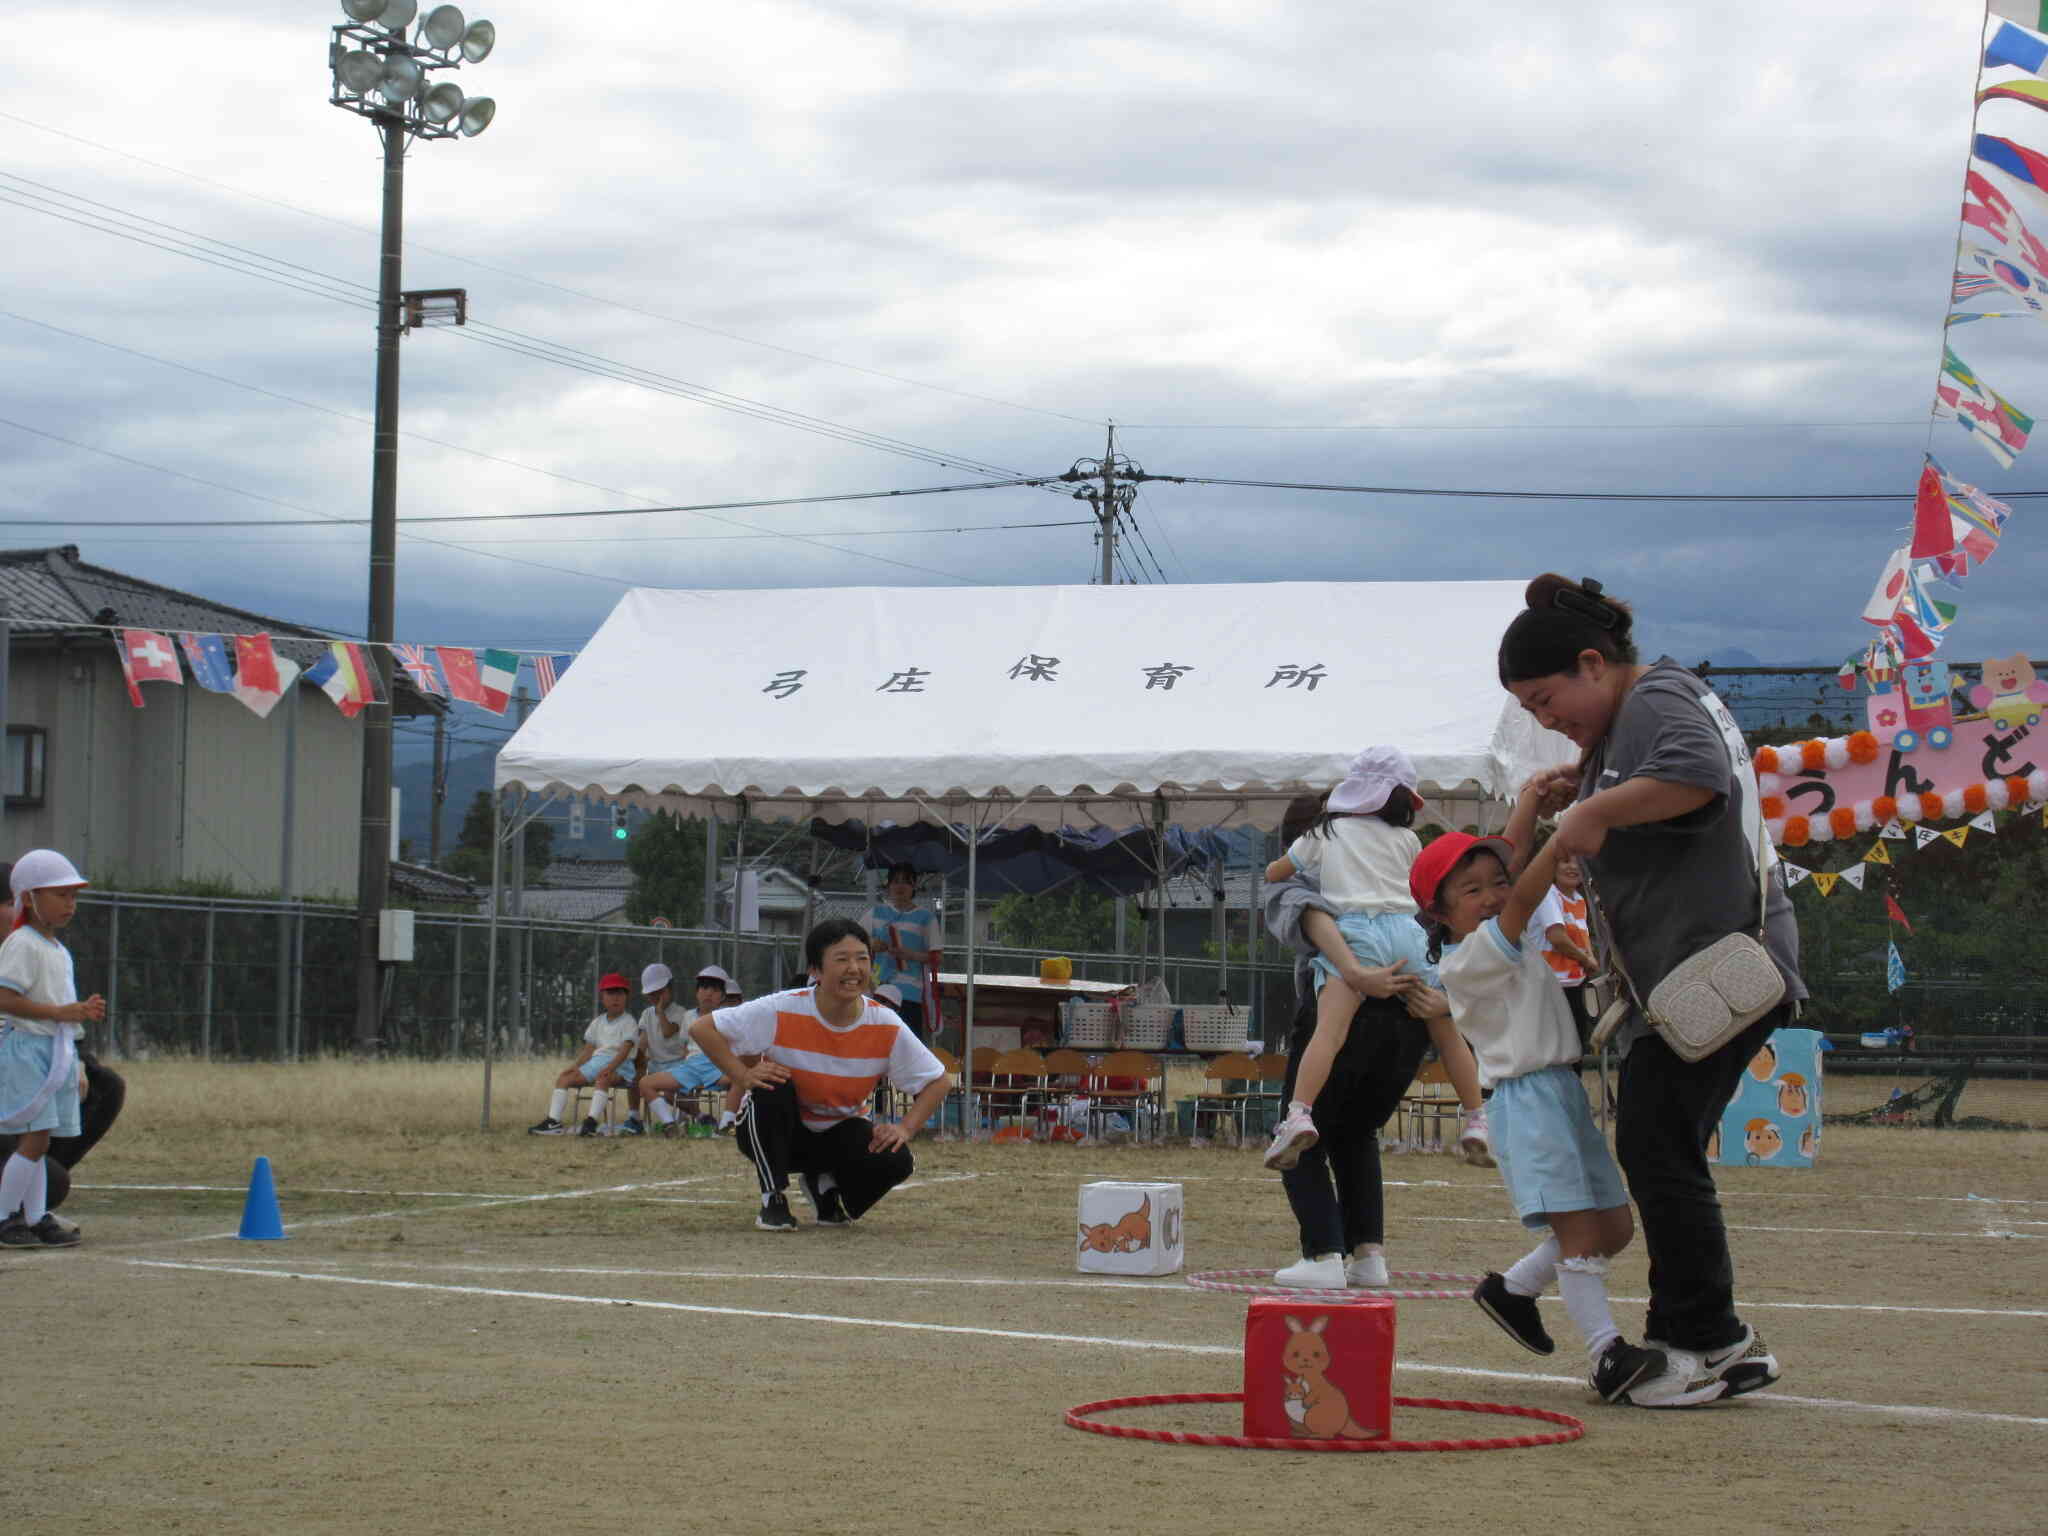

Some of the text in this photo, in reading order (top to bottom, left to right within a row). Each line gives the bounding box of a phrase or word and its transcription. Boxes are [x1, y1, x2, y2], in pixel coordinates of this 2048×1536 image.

[761, 654, 1328, 700] 弓庄保育所
